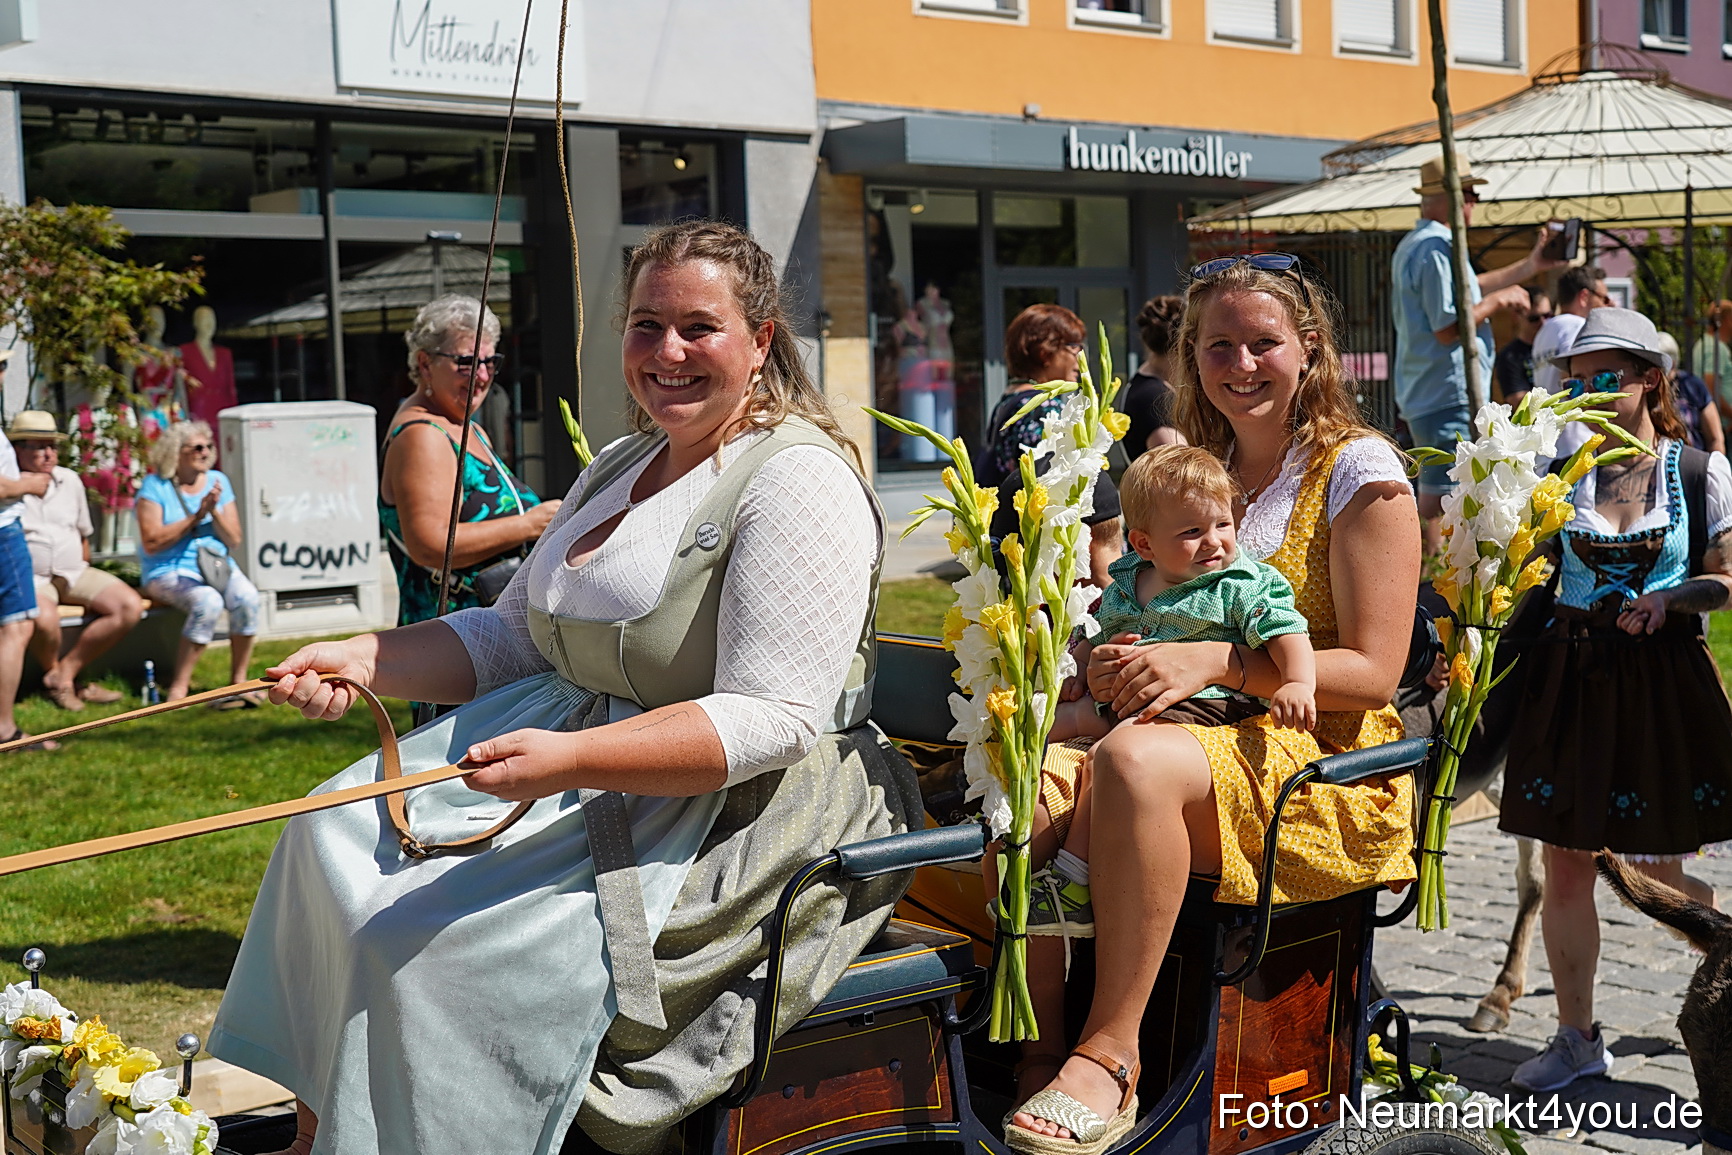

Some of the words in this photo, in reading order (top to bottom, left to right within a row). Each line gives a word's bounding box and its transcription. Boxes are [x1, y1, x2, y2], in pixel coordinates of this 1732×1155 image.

[390, 0, 540, 66] Mittendrin
[1069, 126, 1253, 178] hunkemöller
[258, 541, 371, 570] CLOWN
